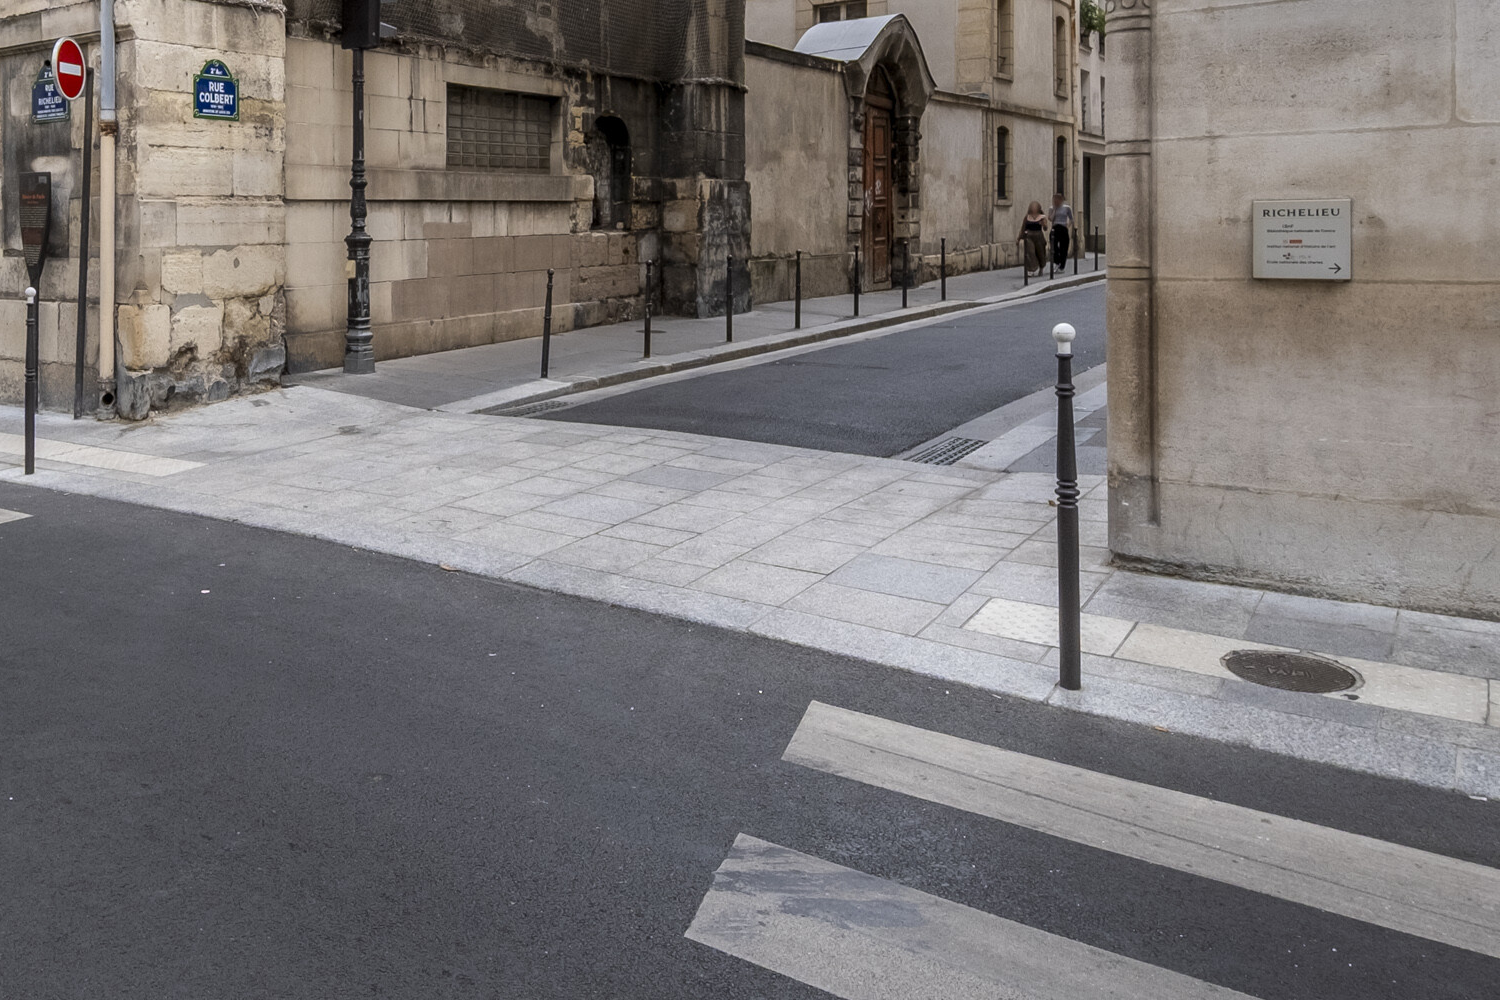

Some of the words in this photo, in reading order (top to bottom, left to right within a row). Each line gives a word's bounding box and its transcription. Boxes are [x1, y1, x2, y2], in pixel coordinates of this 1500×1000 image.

[44, 83, 55, 92] RUE
[208, 81, 225, 93] RUE
[199, 91, 234, 105] COLBERT
[1262, 207, 1341, 218] RICHELIEU
